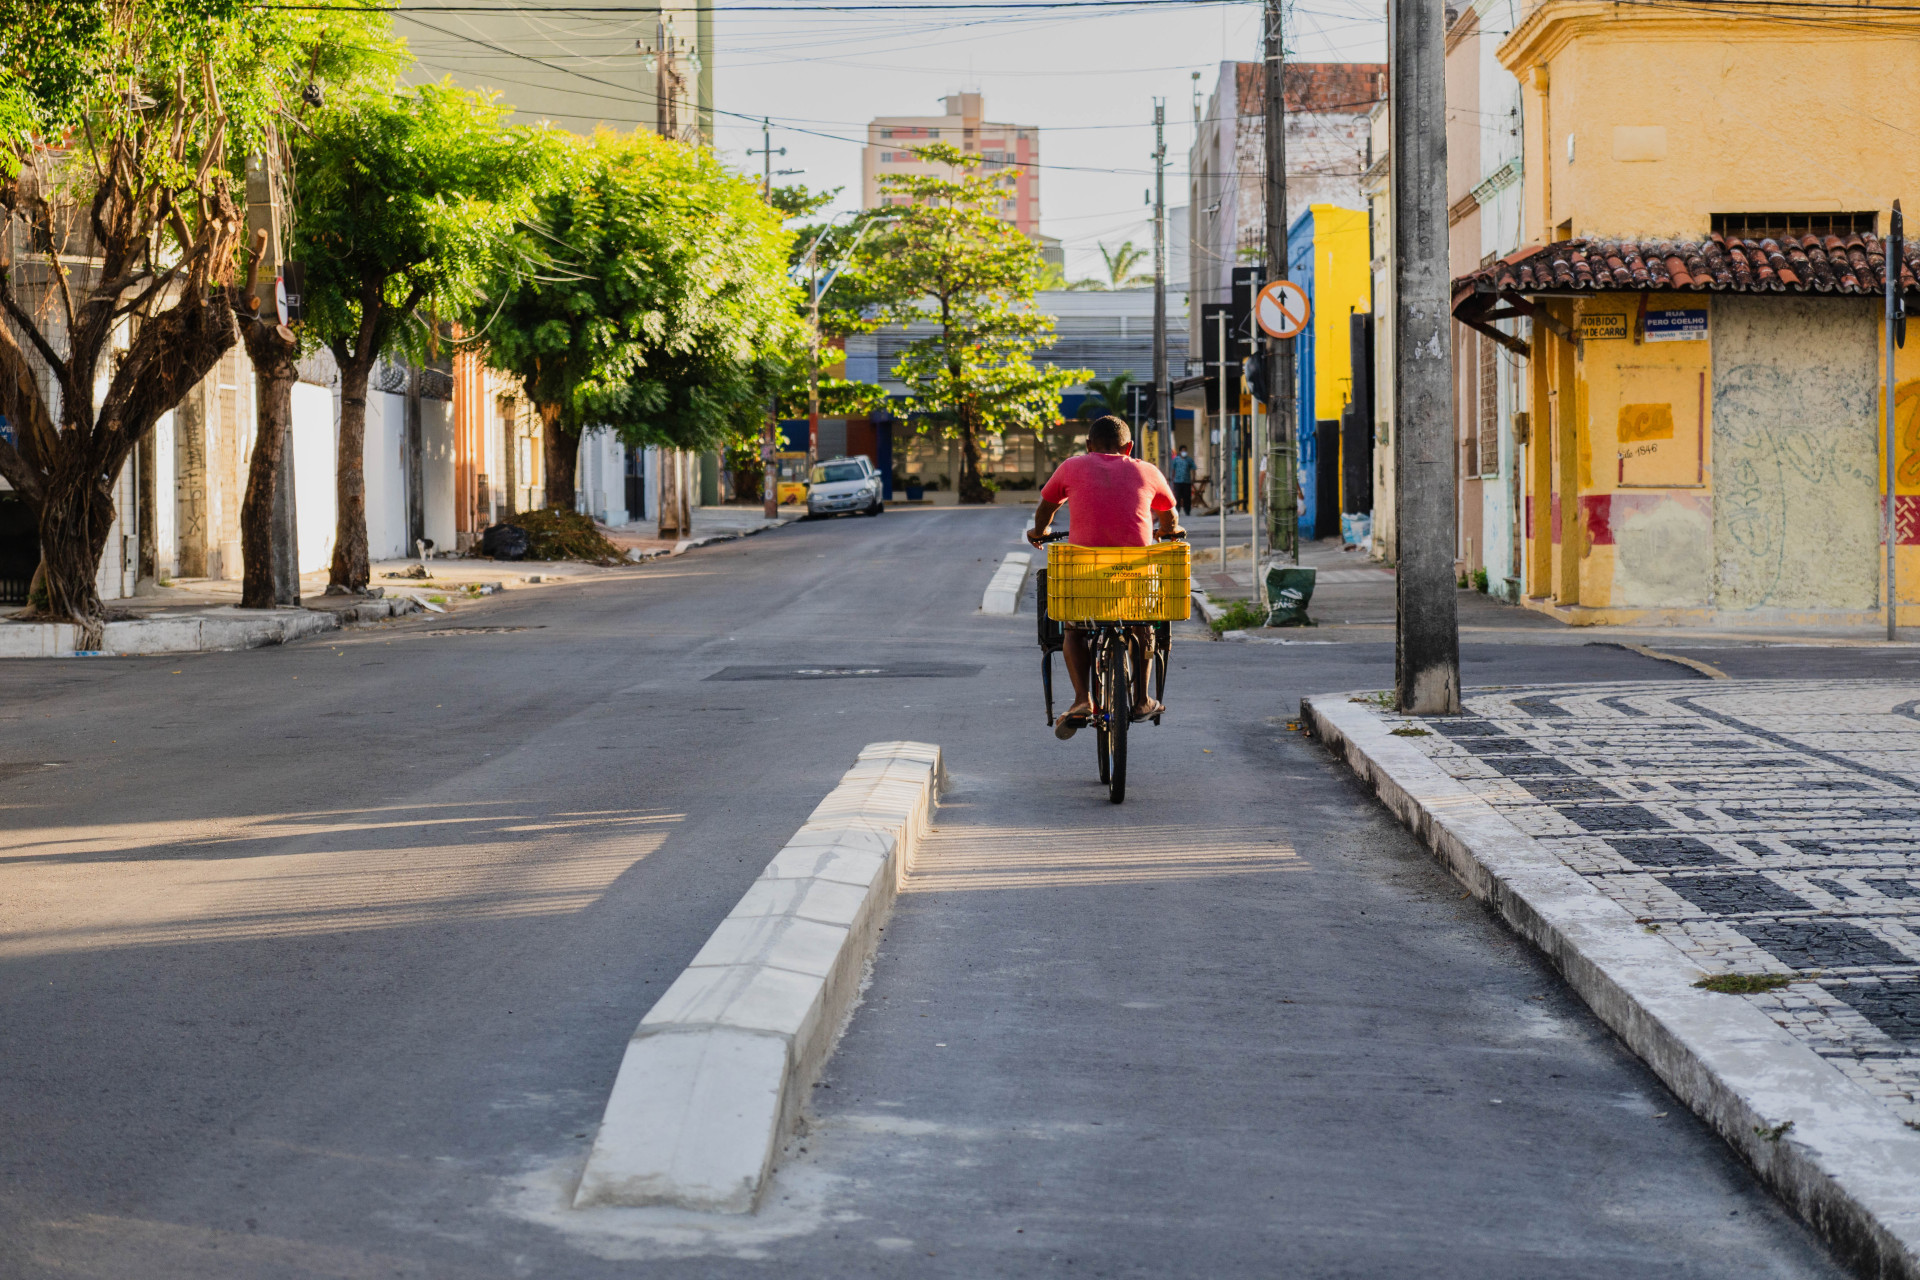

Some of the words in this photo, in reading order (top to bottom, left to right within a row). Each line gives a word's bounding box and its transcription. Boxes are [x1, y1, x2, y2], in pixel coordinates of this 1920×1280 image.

[1580, 317, 1618, 327] ROIBIDO
[1590, 328, 1598, 337] DE
[1599, 327, 1625, 337] CARRO
[1637, 443, 1658, 457] 1846
